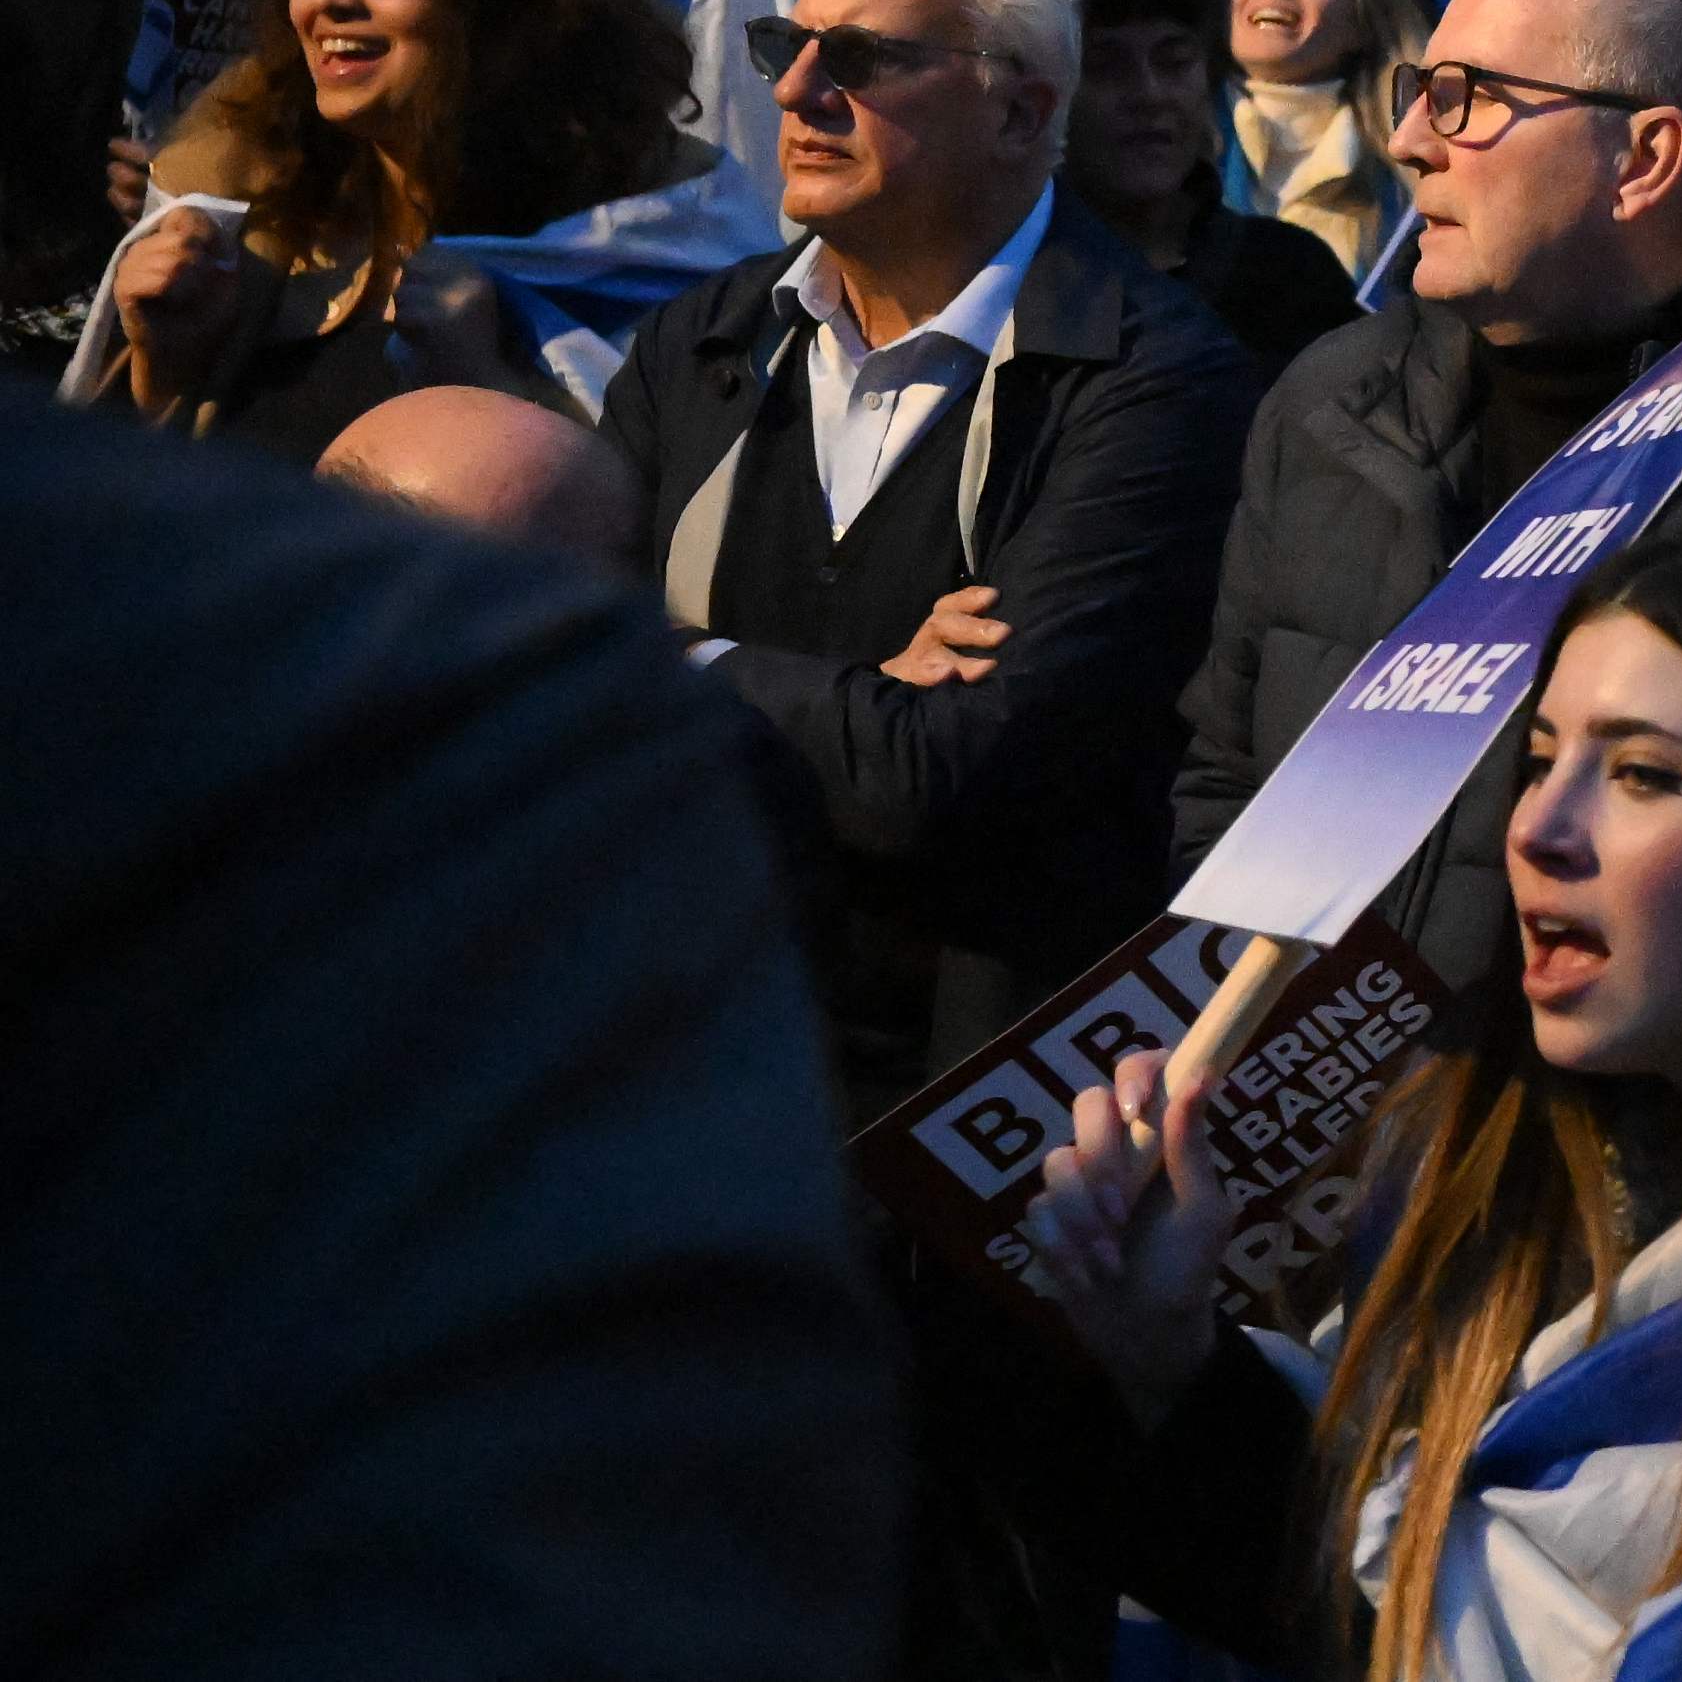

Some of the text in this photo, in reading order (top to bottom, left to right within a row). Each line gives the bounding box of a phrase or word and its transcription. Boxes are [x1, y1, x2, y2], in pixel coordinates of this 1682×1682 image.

[1564, 400, 1619, 458] I
[1480, 501, 1634, 581] WITH
[1348, 640, 1532, 716] ISRAEL
[1241, 990, 1434, 1154] BABIES
[1223, 1079, 1386, 1213] ALLED
